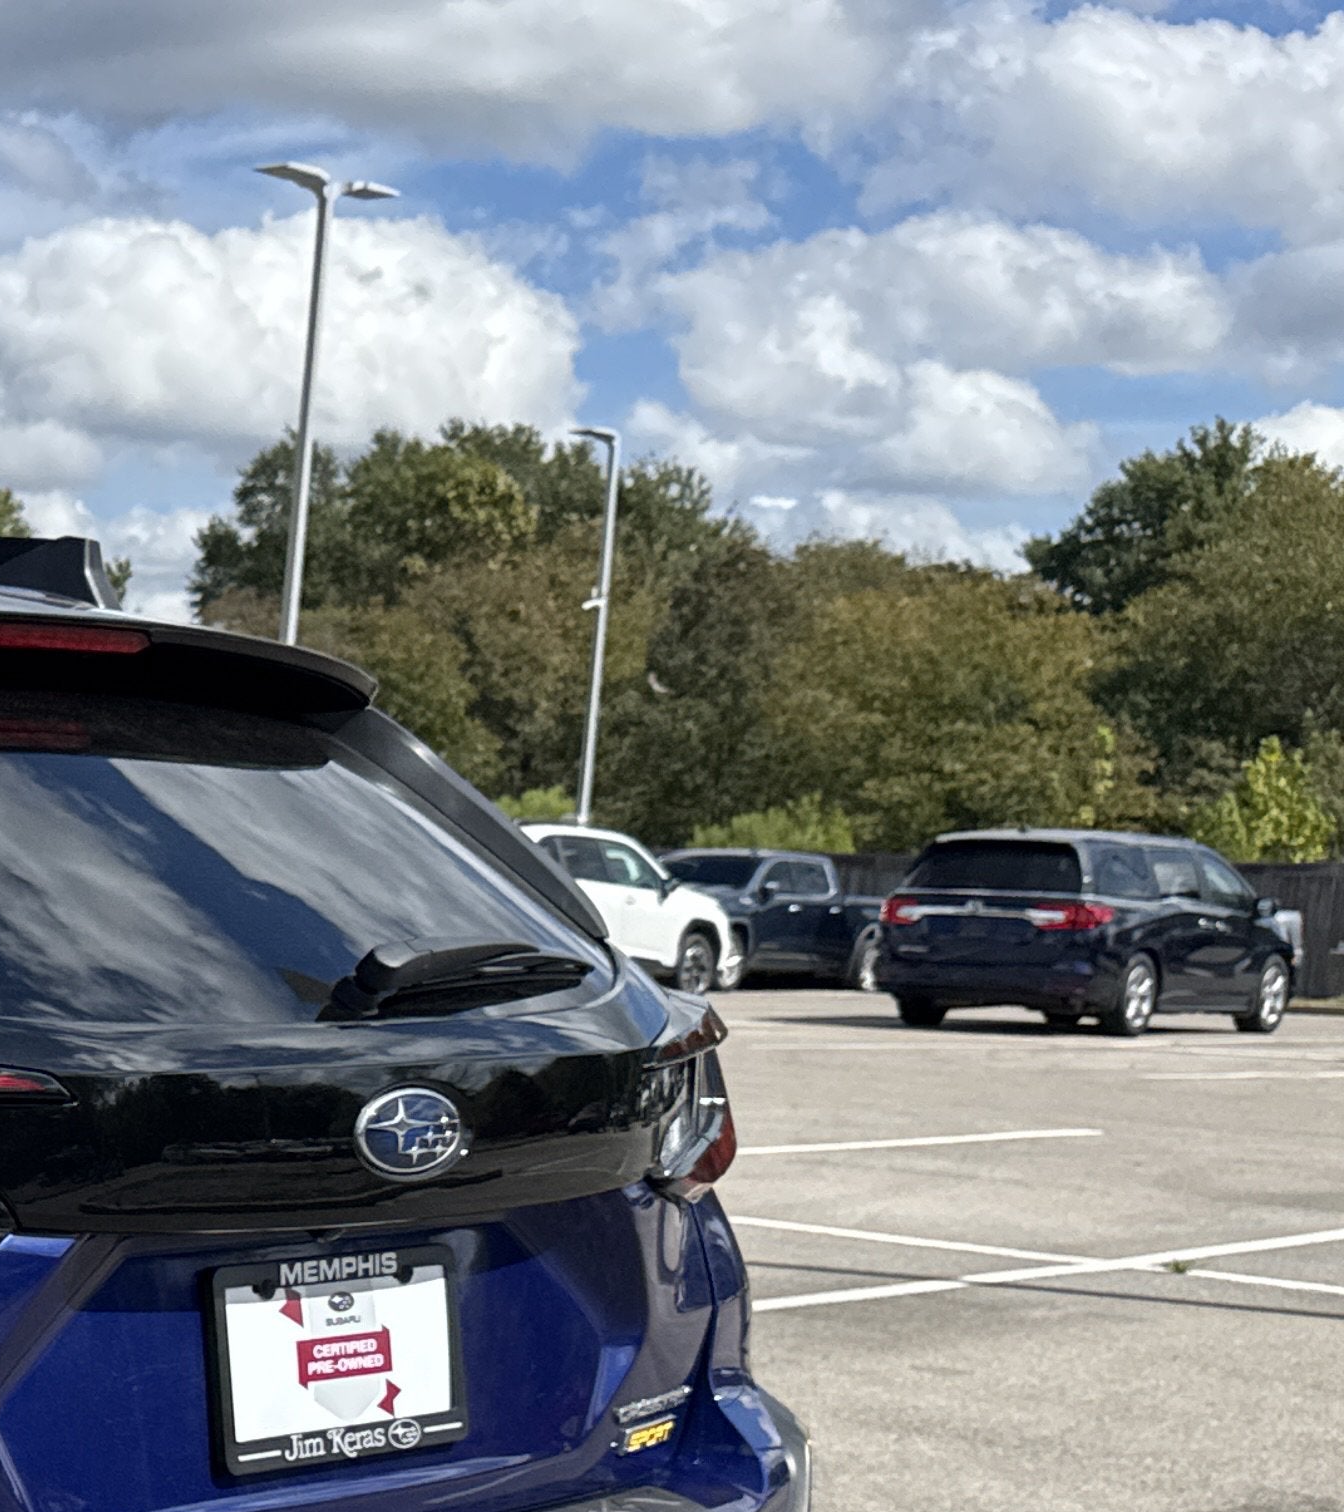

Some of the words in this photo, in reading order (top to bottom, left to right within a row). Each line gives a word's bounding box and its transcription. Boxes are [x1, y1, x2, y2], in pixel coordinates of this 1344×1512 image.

[279, 1252, 398, 1286] MEMPHIS
[325, 1315, 362, 1327] SUBARU
[313, 1338, 378, 1359] CERTIFIED
[307, 1353, 384, 1376] PRE-OWNED
[284, 1435, 325, 1461] Jim
[326, 1427, 387, 1458] Keras
